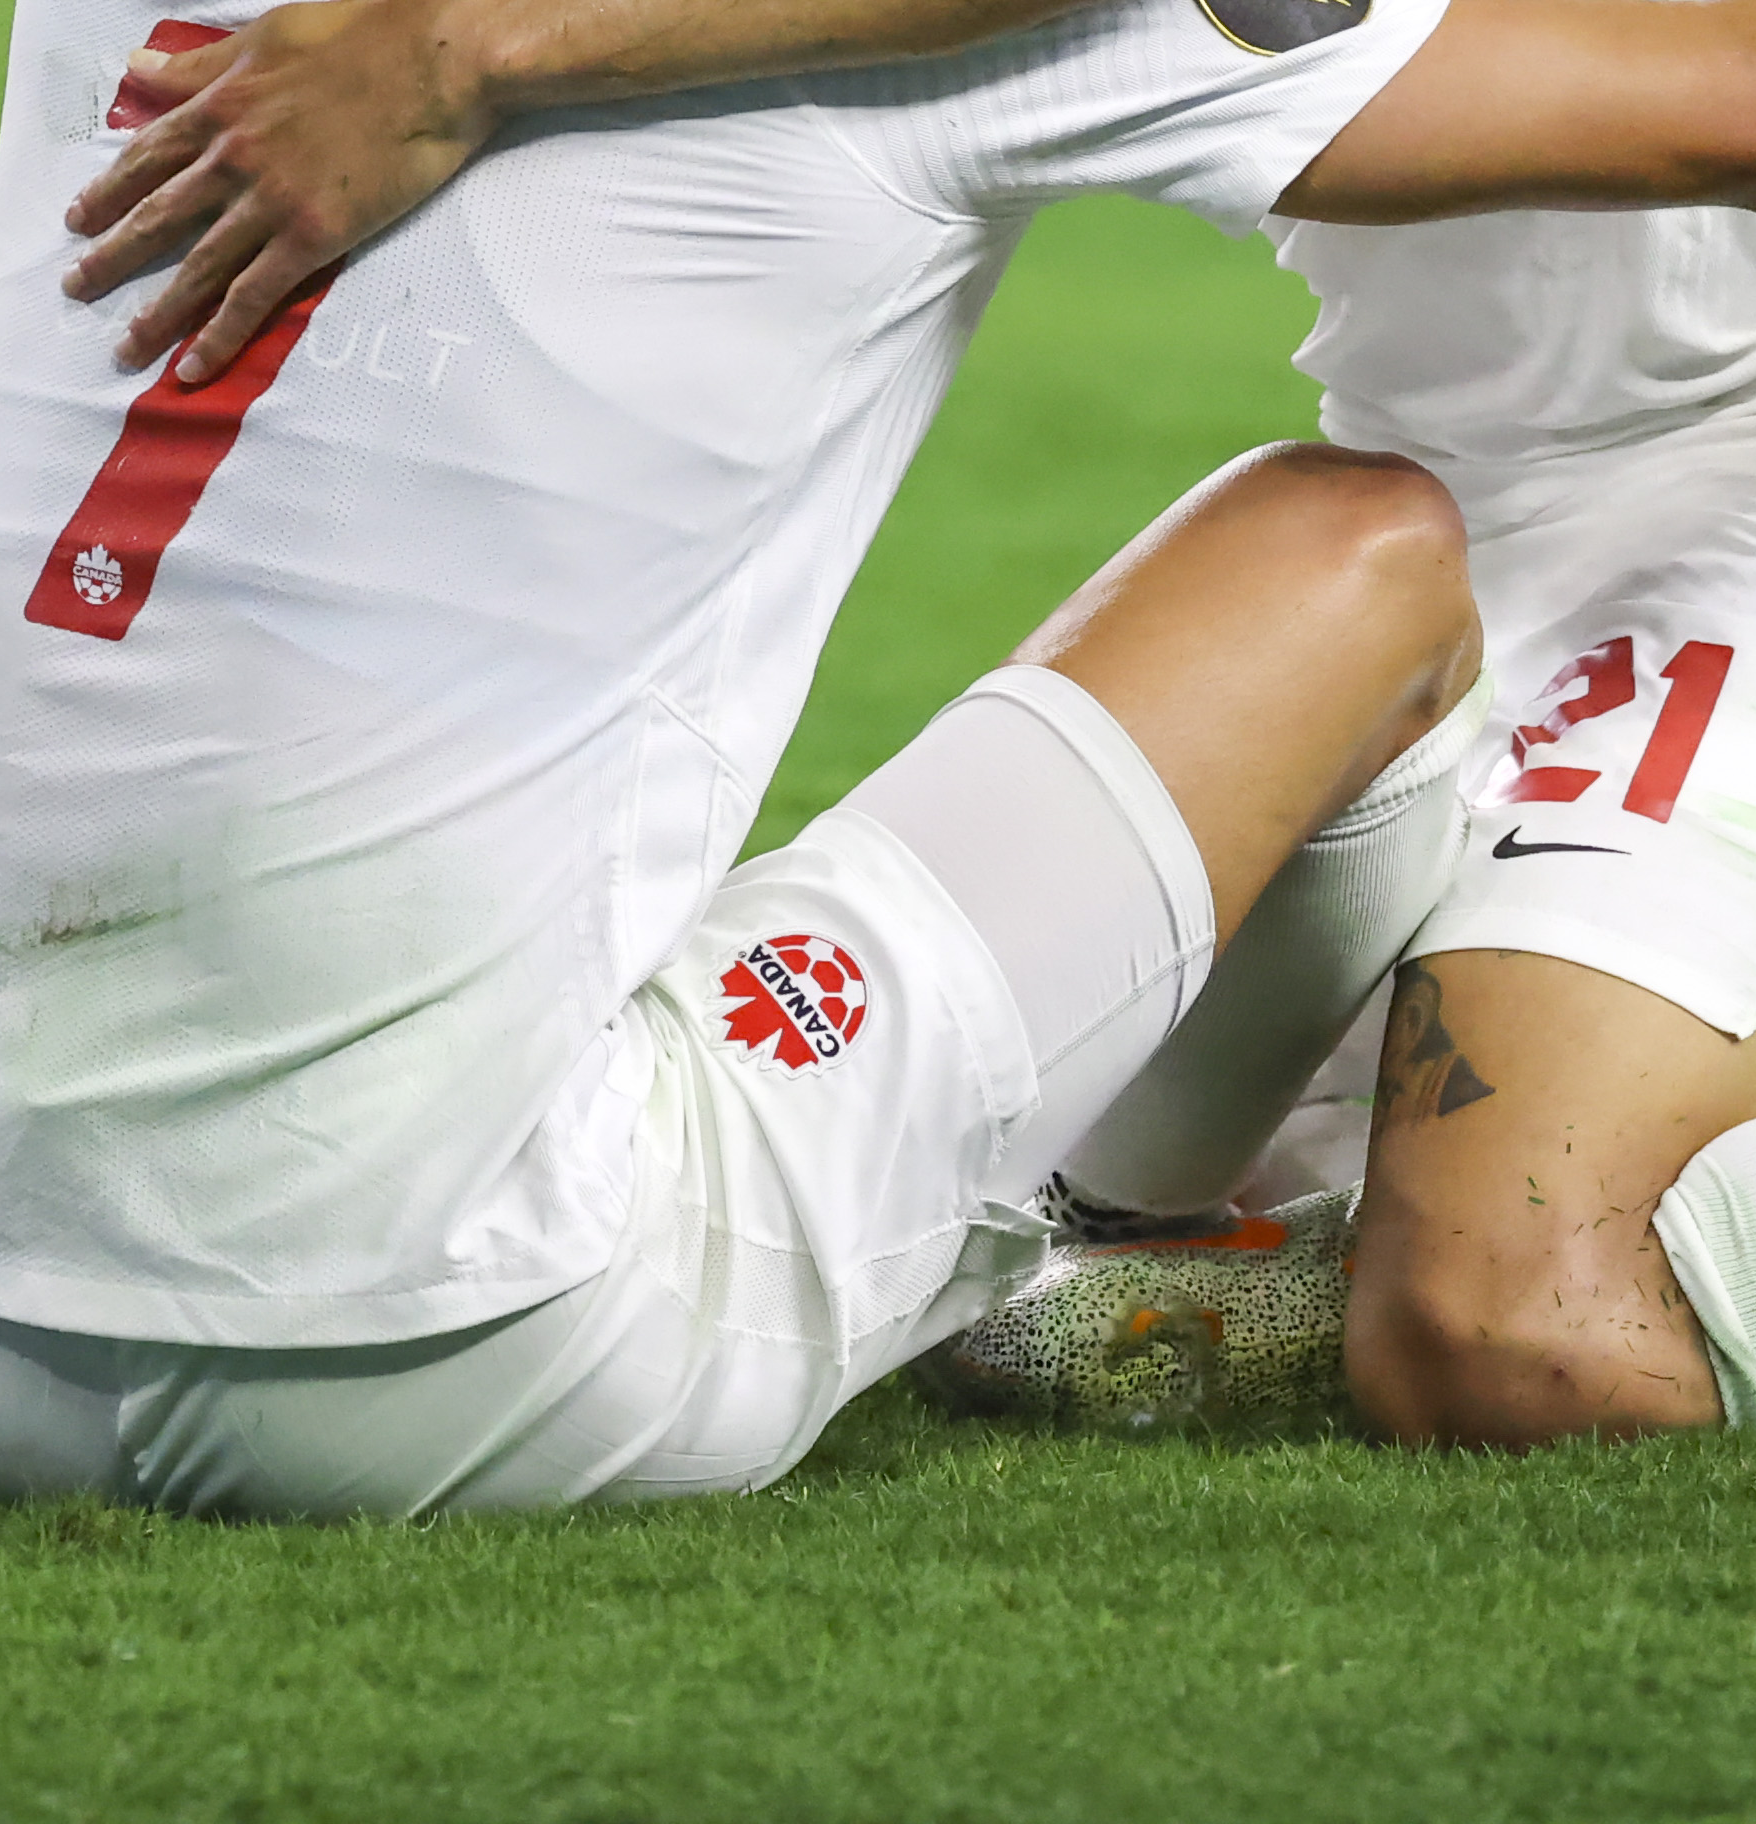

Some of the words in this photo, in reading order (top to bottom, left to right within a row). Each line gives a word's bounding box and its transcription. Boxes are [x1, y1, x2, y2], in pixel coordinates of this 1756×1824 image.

[73, 565, 123, 586] CANADA
[1471, 635, 1735, 824] 21
[747, 943, 840, 1058] CANADA
